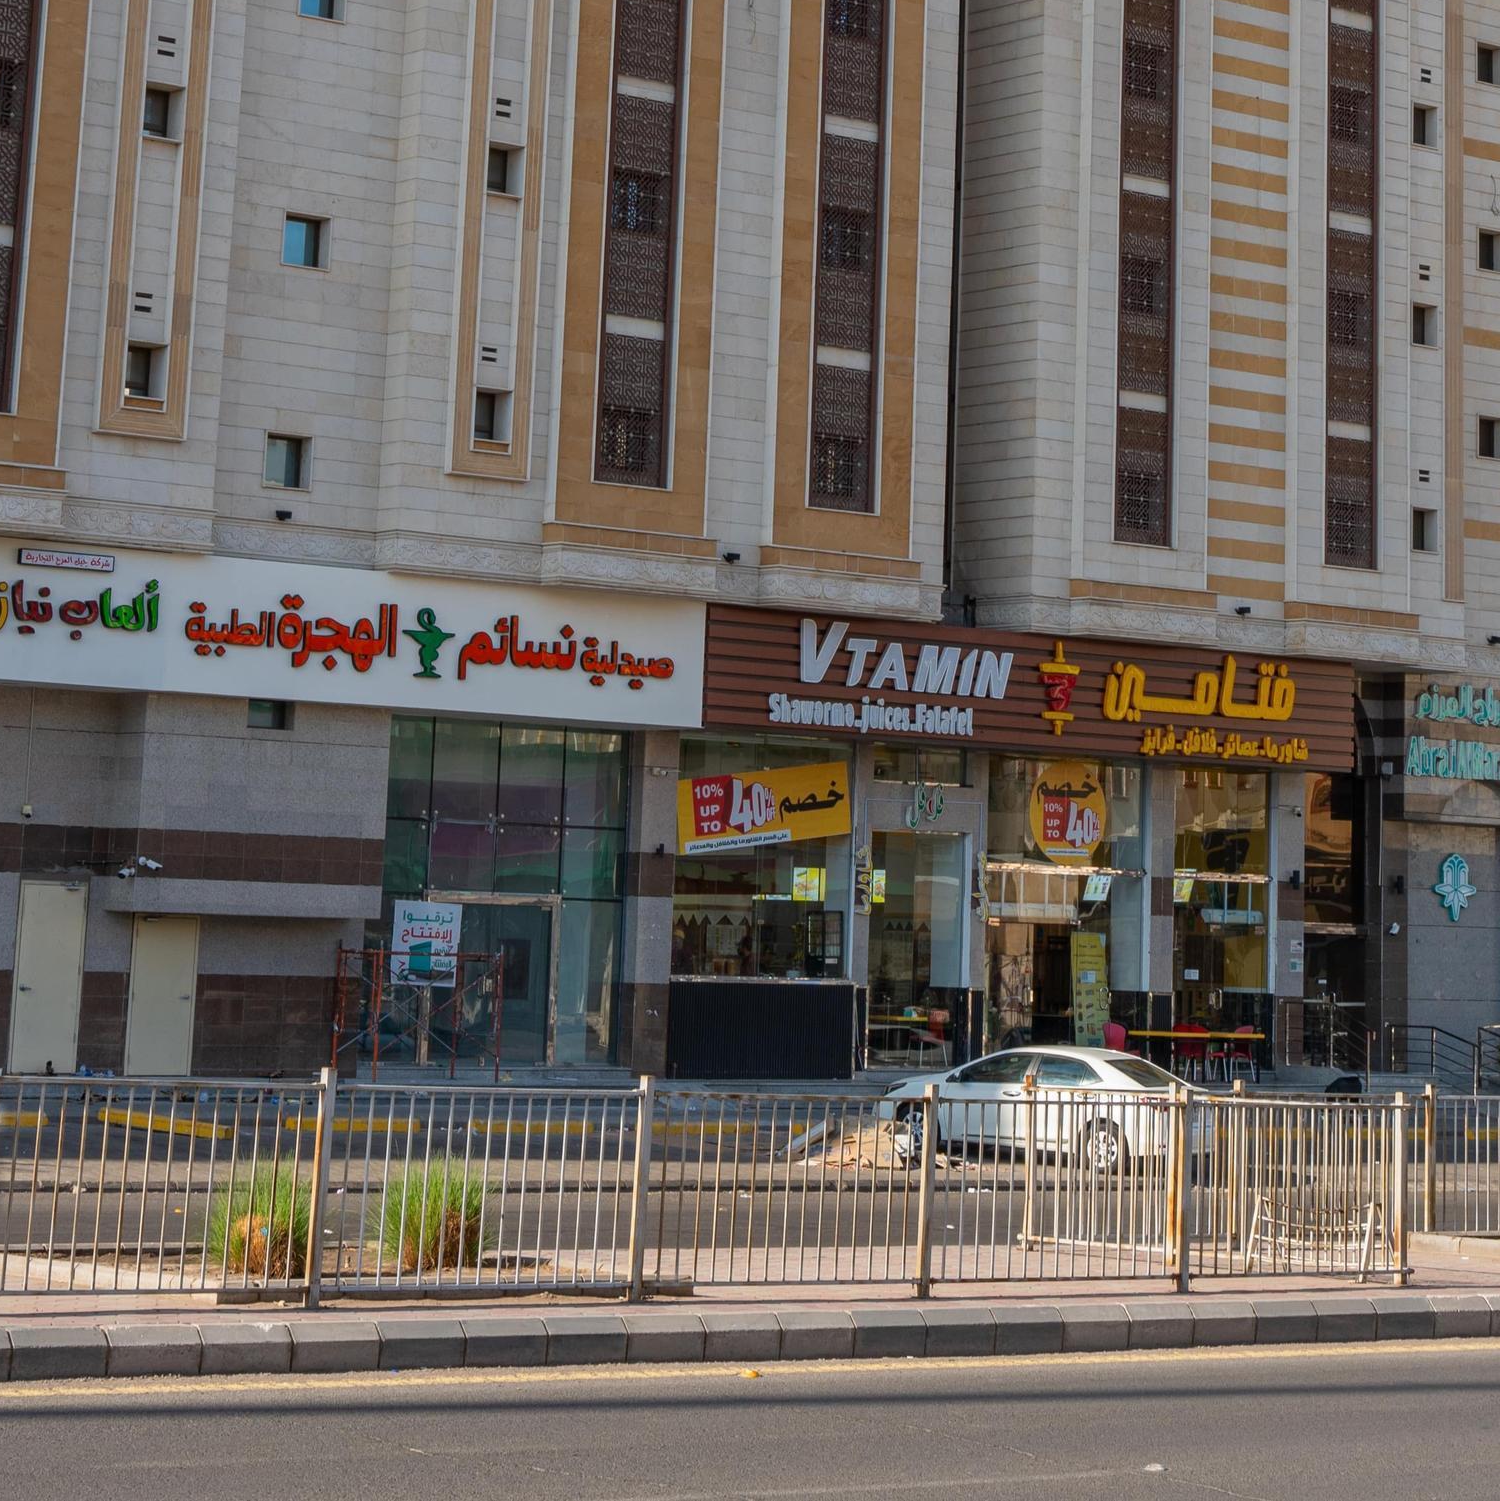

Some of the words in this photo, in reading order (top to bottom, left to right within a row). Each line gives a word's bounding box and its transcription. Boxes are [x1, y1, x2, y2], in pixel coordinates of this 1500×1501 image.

[184, 601, 277, 657] الطبية
[277, 594, 399, 673] الهجرة
[456, 614, 578, 681] نسائم
[580, 635, 675, 690] صيدلية
[1102, 653, 1296, 722] فتامين
[694, 783, 724, 800] 10%
[1037, 773, 1098, 805] خصم
[700, 804, 721, 817] UP
[779, 780, 845, 823] خصم
[1044, 803, 1064, 813] 10%
[700, 821, 722, 834] TO
[1046, 818, 1061, 827] UP
[1046, 830, 1060, 838] TO
[403, 909, 454, 925] ترقبوا
